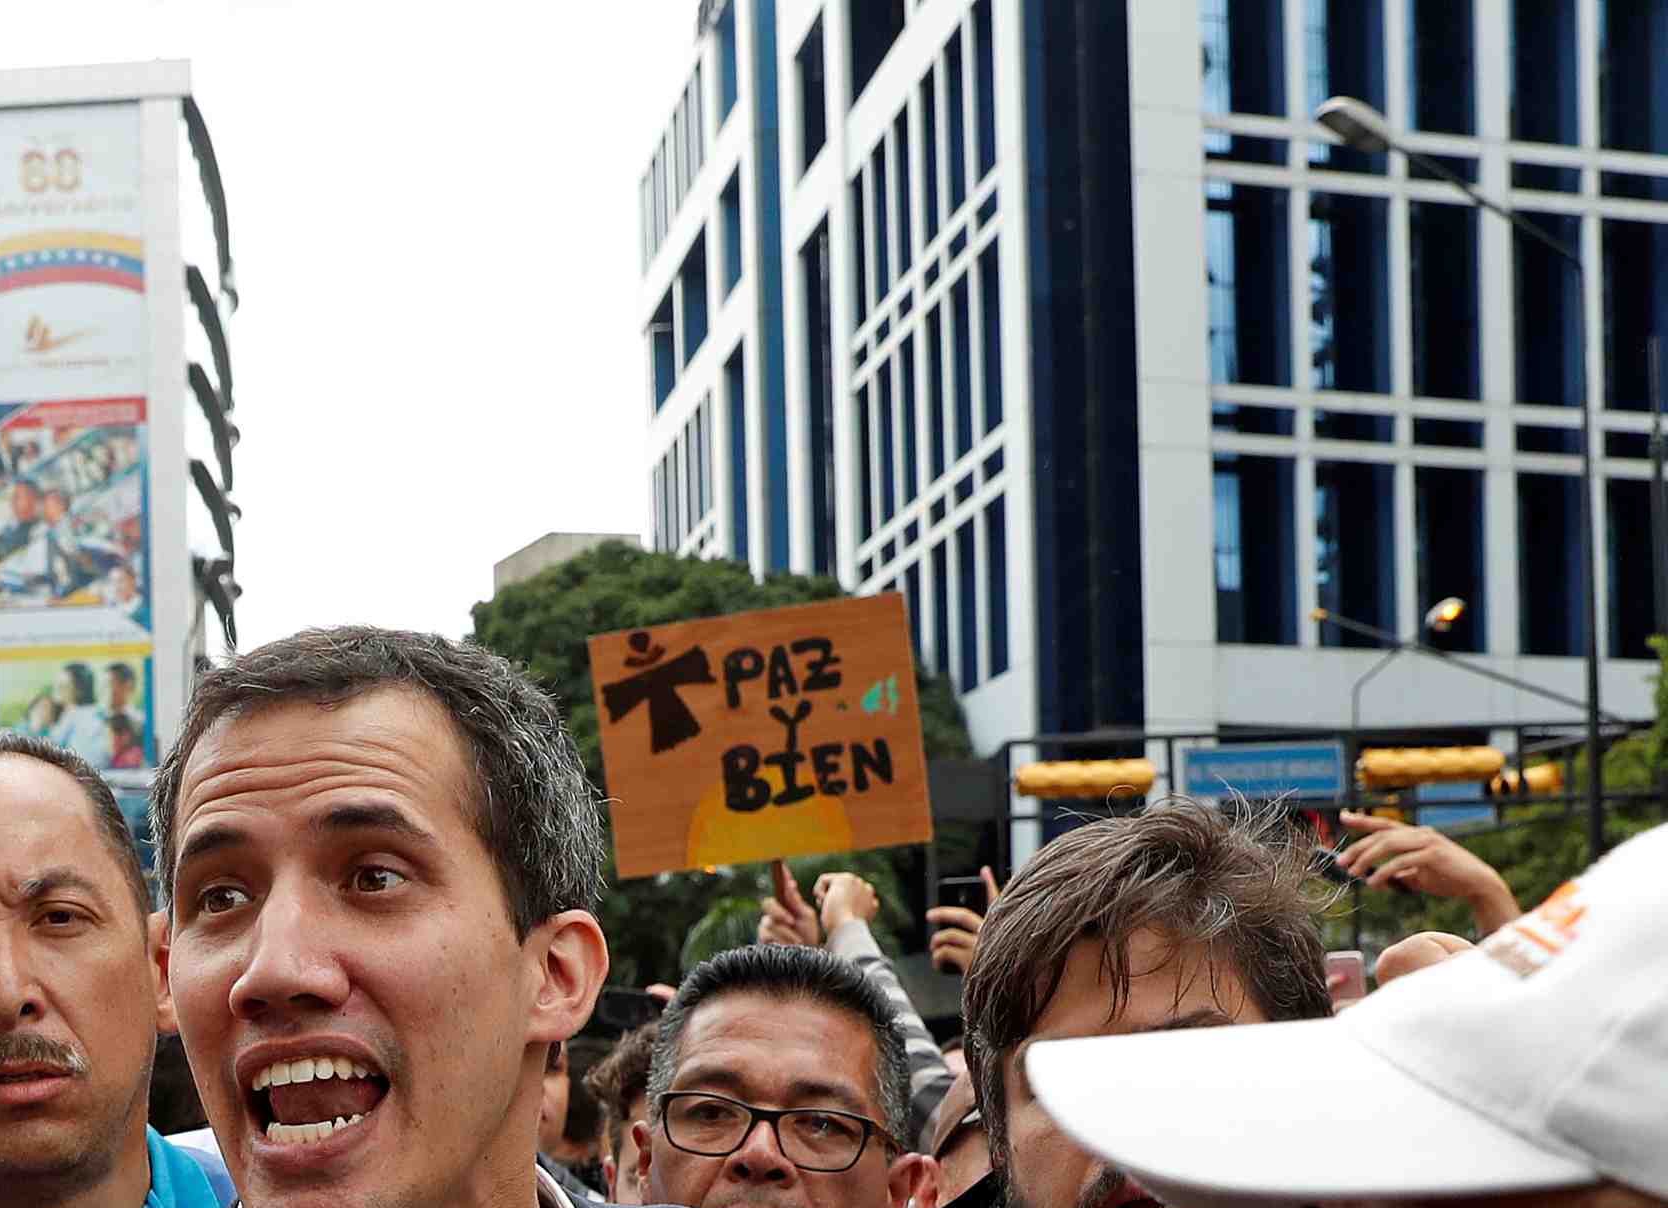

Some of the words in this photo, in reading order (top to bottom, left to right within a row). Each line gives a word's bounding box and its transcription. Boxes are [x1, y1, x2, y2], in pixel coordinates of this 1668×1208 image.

[722, 637, 842, 709] PAZ
[769, 700, 812, 751] Y
[721, 737, 893, 813] BIEN
